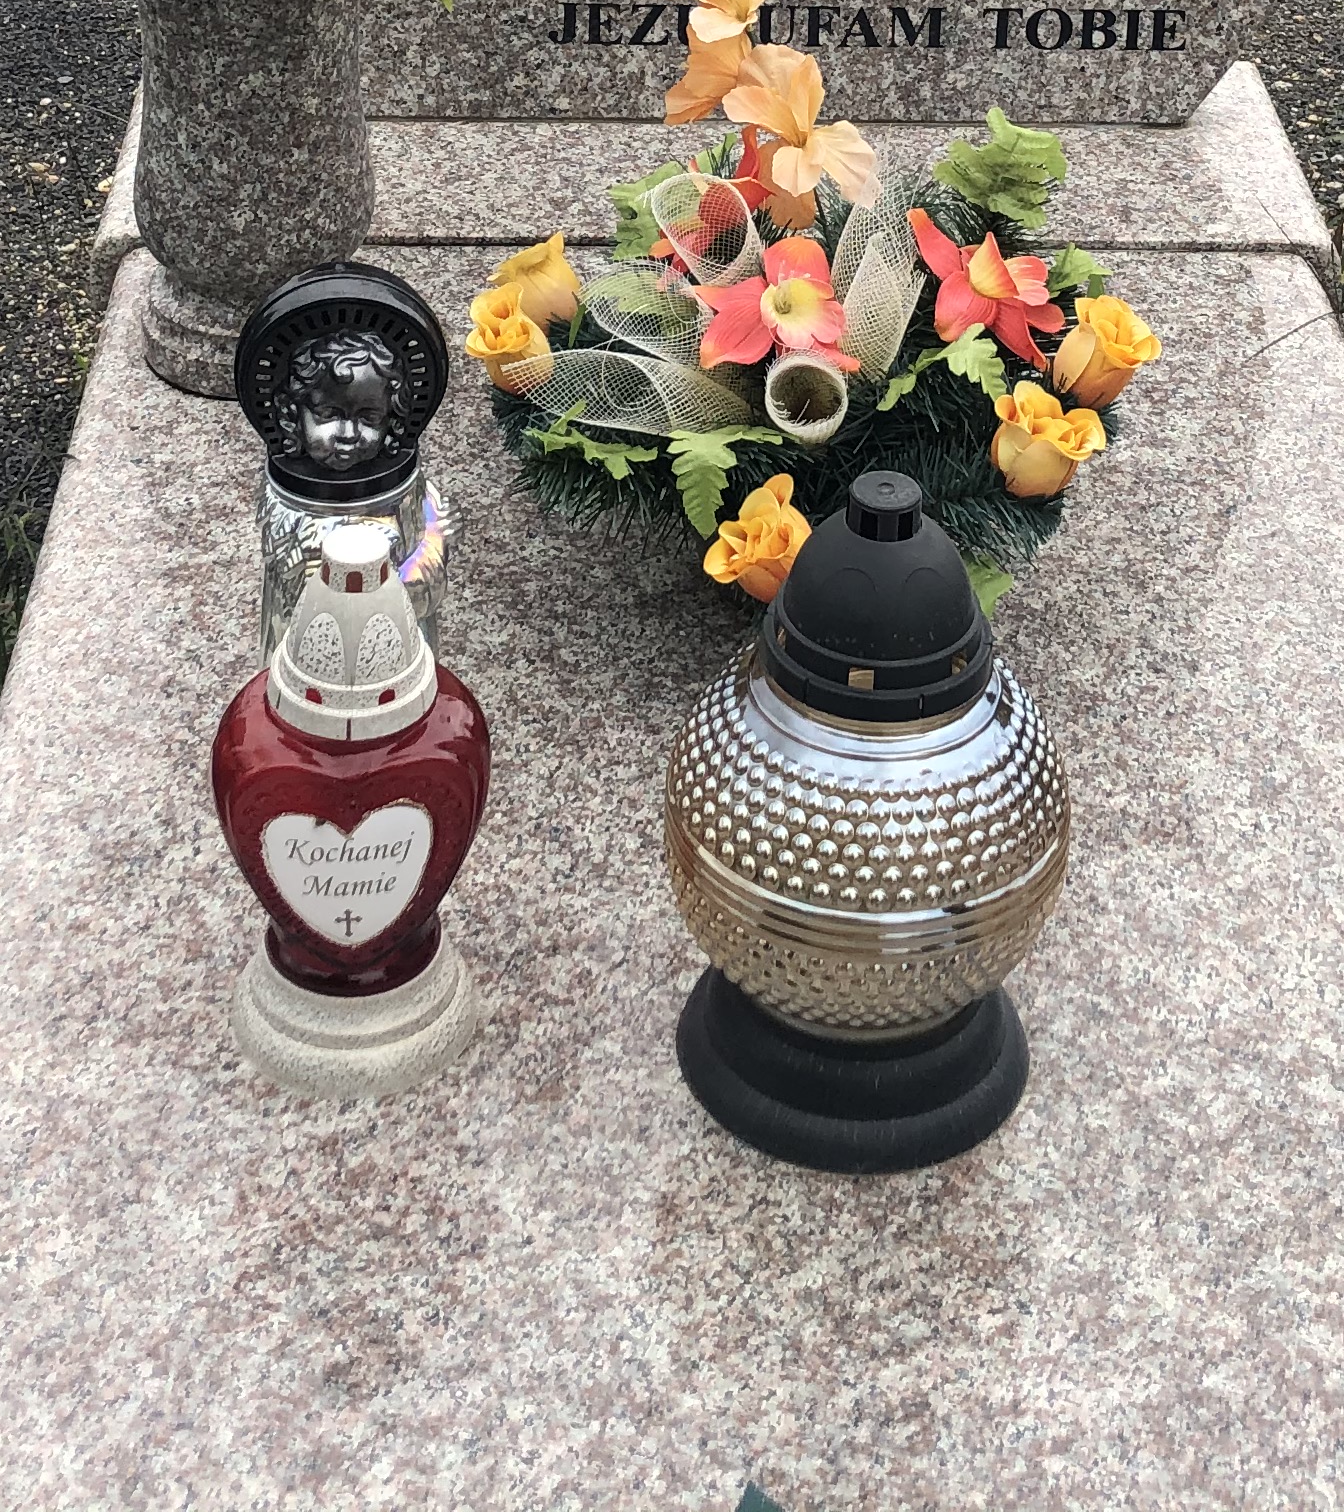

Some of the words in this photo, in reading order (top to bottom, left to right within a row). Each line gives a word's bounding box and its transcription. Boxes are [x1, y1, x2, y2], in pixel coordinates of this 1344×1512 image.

[757, 4, 947, 49] UFAM
[982, 7, 1187, 51] TOBIE
[284, 831, 416, 866] Kochanej
[301, 871, 398, 898] Mamie
